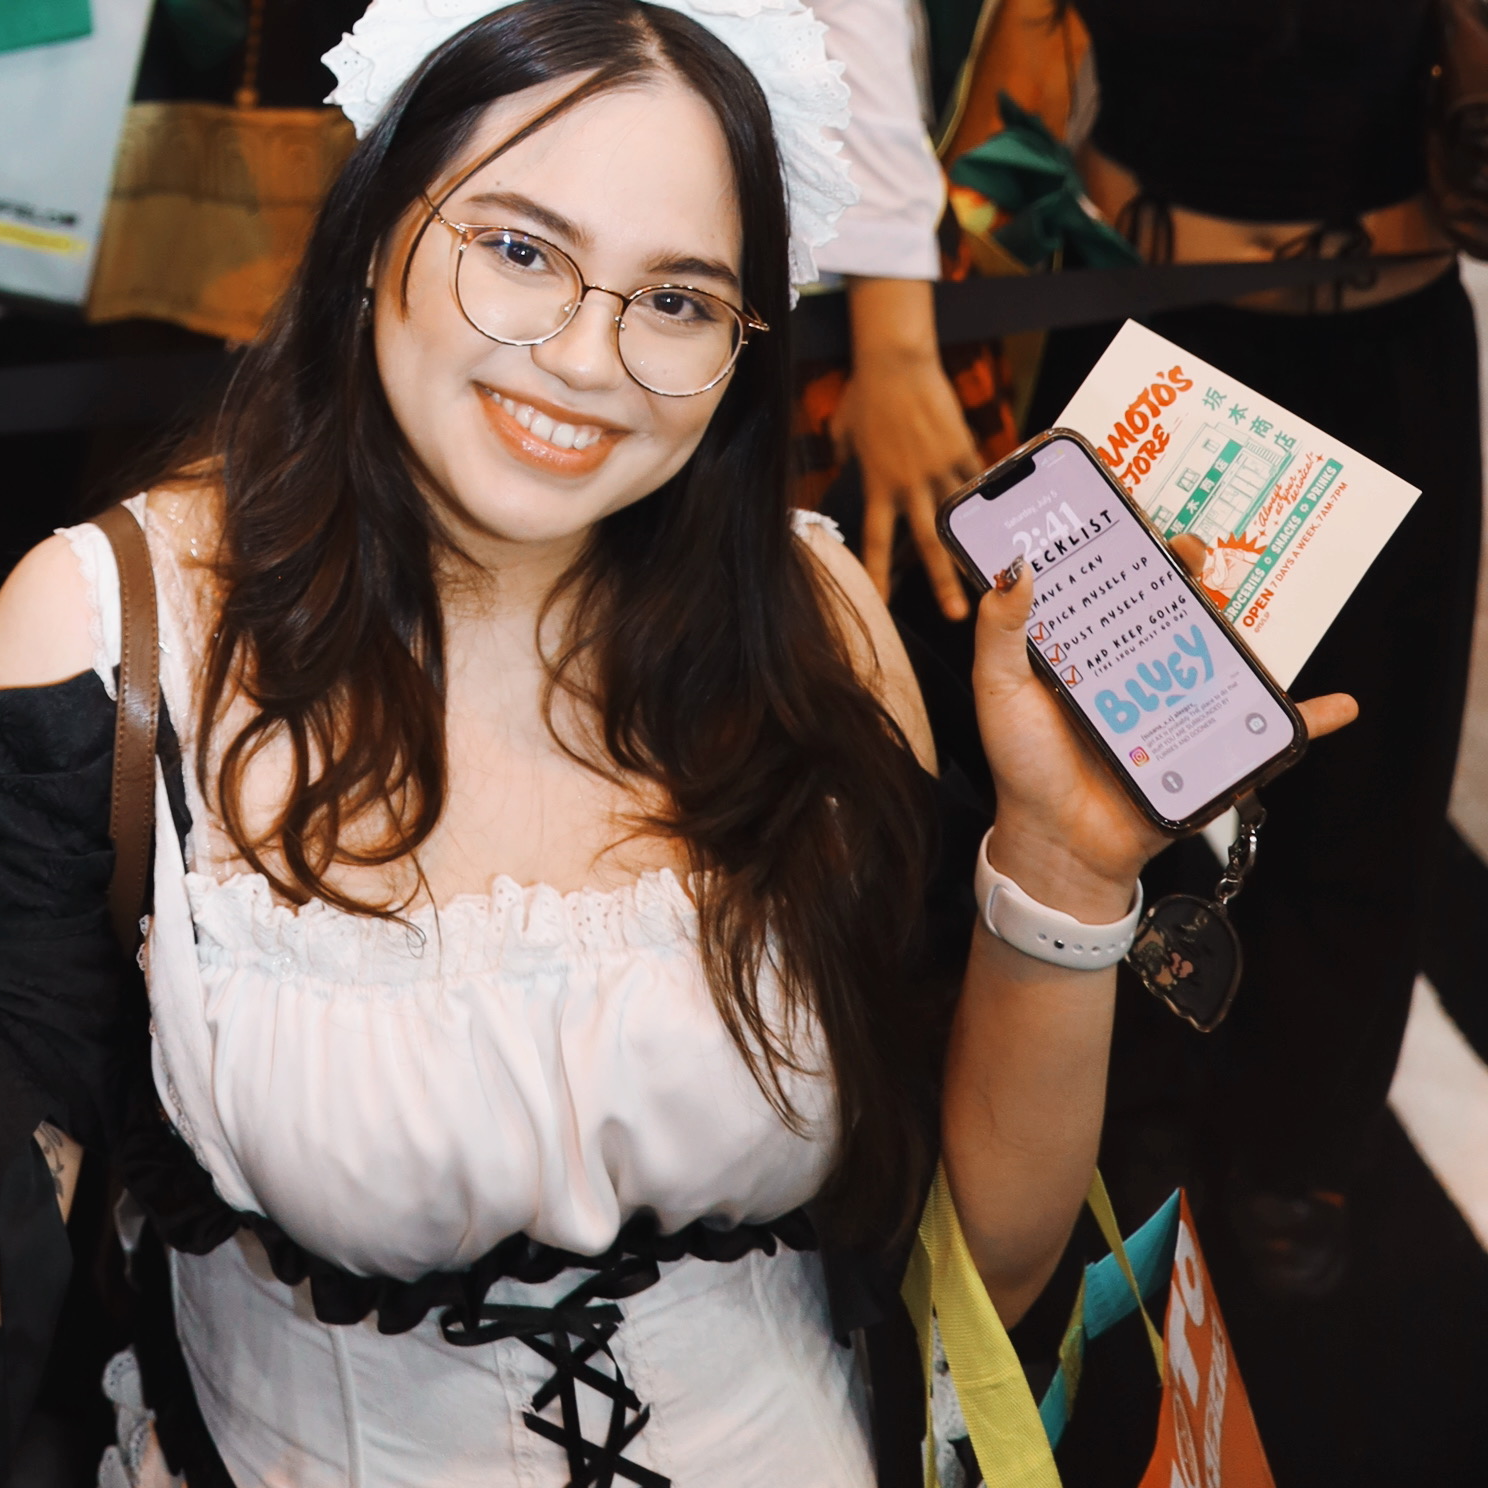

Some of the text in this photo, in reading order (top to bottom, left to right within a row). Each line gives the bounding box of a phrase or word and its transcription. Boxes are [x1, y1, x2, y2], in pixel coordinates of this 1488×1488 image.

[1202, 387, 1296, 451] 坂本商店
[1009, 499, 1086, 564] 2:41
[1035, 492, 1054, 509] July
[1268, 512, 1303, 555] SNACKS
[1304, 463, 1337, 503] DRINKS
[1030, 554, 1104, 609] HAVE A CRY
[1240, 479, 1348, 629] OPEN 7 DAYS A WEEK, 7AM-7PM
[1047, 555, 1150, 630] PICK MYSELF UP
[1062, 569, 1175, 651] DUST MYSELF OFF
[1084, 593, 1188, 669] AND KEEP GOING
[1114, 644, 1136, 662] SHOW
[1136, 629, 1158, 646] MUST
[1094, 624, 1214, 734] BLUEY
[1166, 714, 1191, 734] probably
[1199, 697, 1215, 710] place
[1226, 680, 1238, 691] that
[1162, 734, 1176, 746] YOU
[1174, 726, 1187, 737] ARE
[1177, 734, 1191, 746] AND
